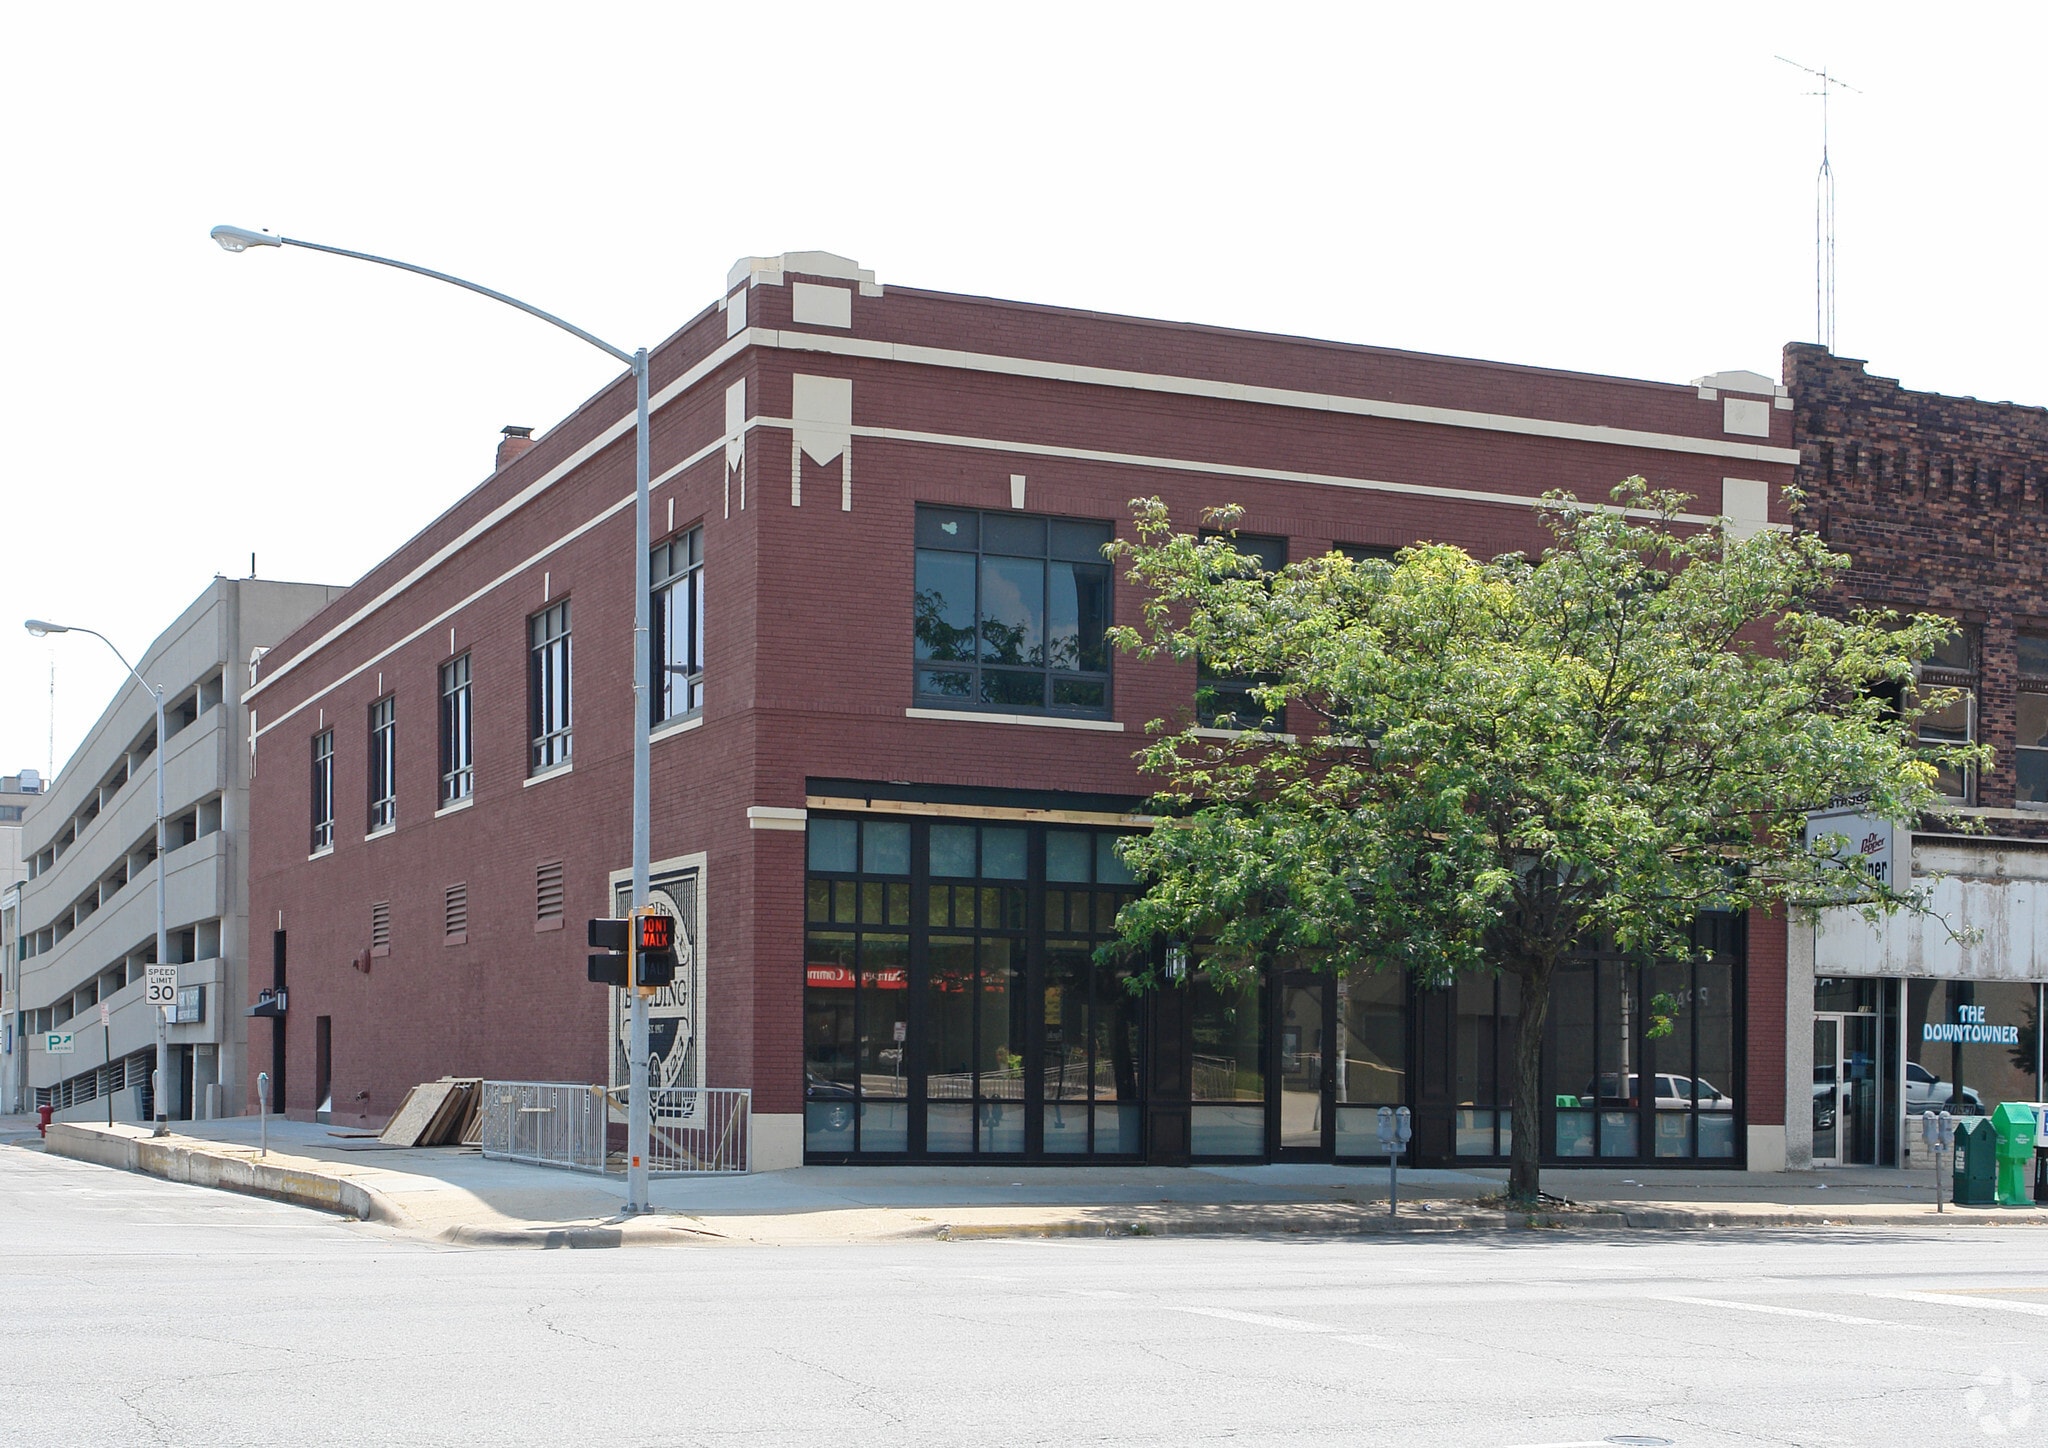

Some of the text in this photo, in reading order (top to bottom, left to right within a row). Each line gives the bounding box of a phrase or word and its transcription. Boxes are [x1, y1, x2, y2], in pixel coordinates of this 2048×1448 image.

[1868, 832, 1879, 843] Dr
[1860, 838, 1886, 854] Pepper
[642, 933, 668, 946] WALK
[148, 968, 176, 976] SPEED
[149, 985, 174, 1000] 30
[625, 980, 687, 1008] BDING
[1958, 1004, 1986, 1023] THE
[1923, 1023, 2019, 1044] DOWNTOWNER
